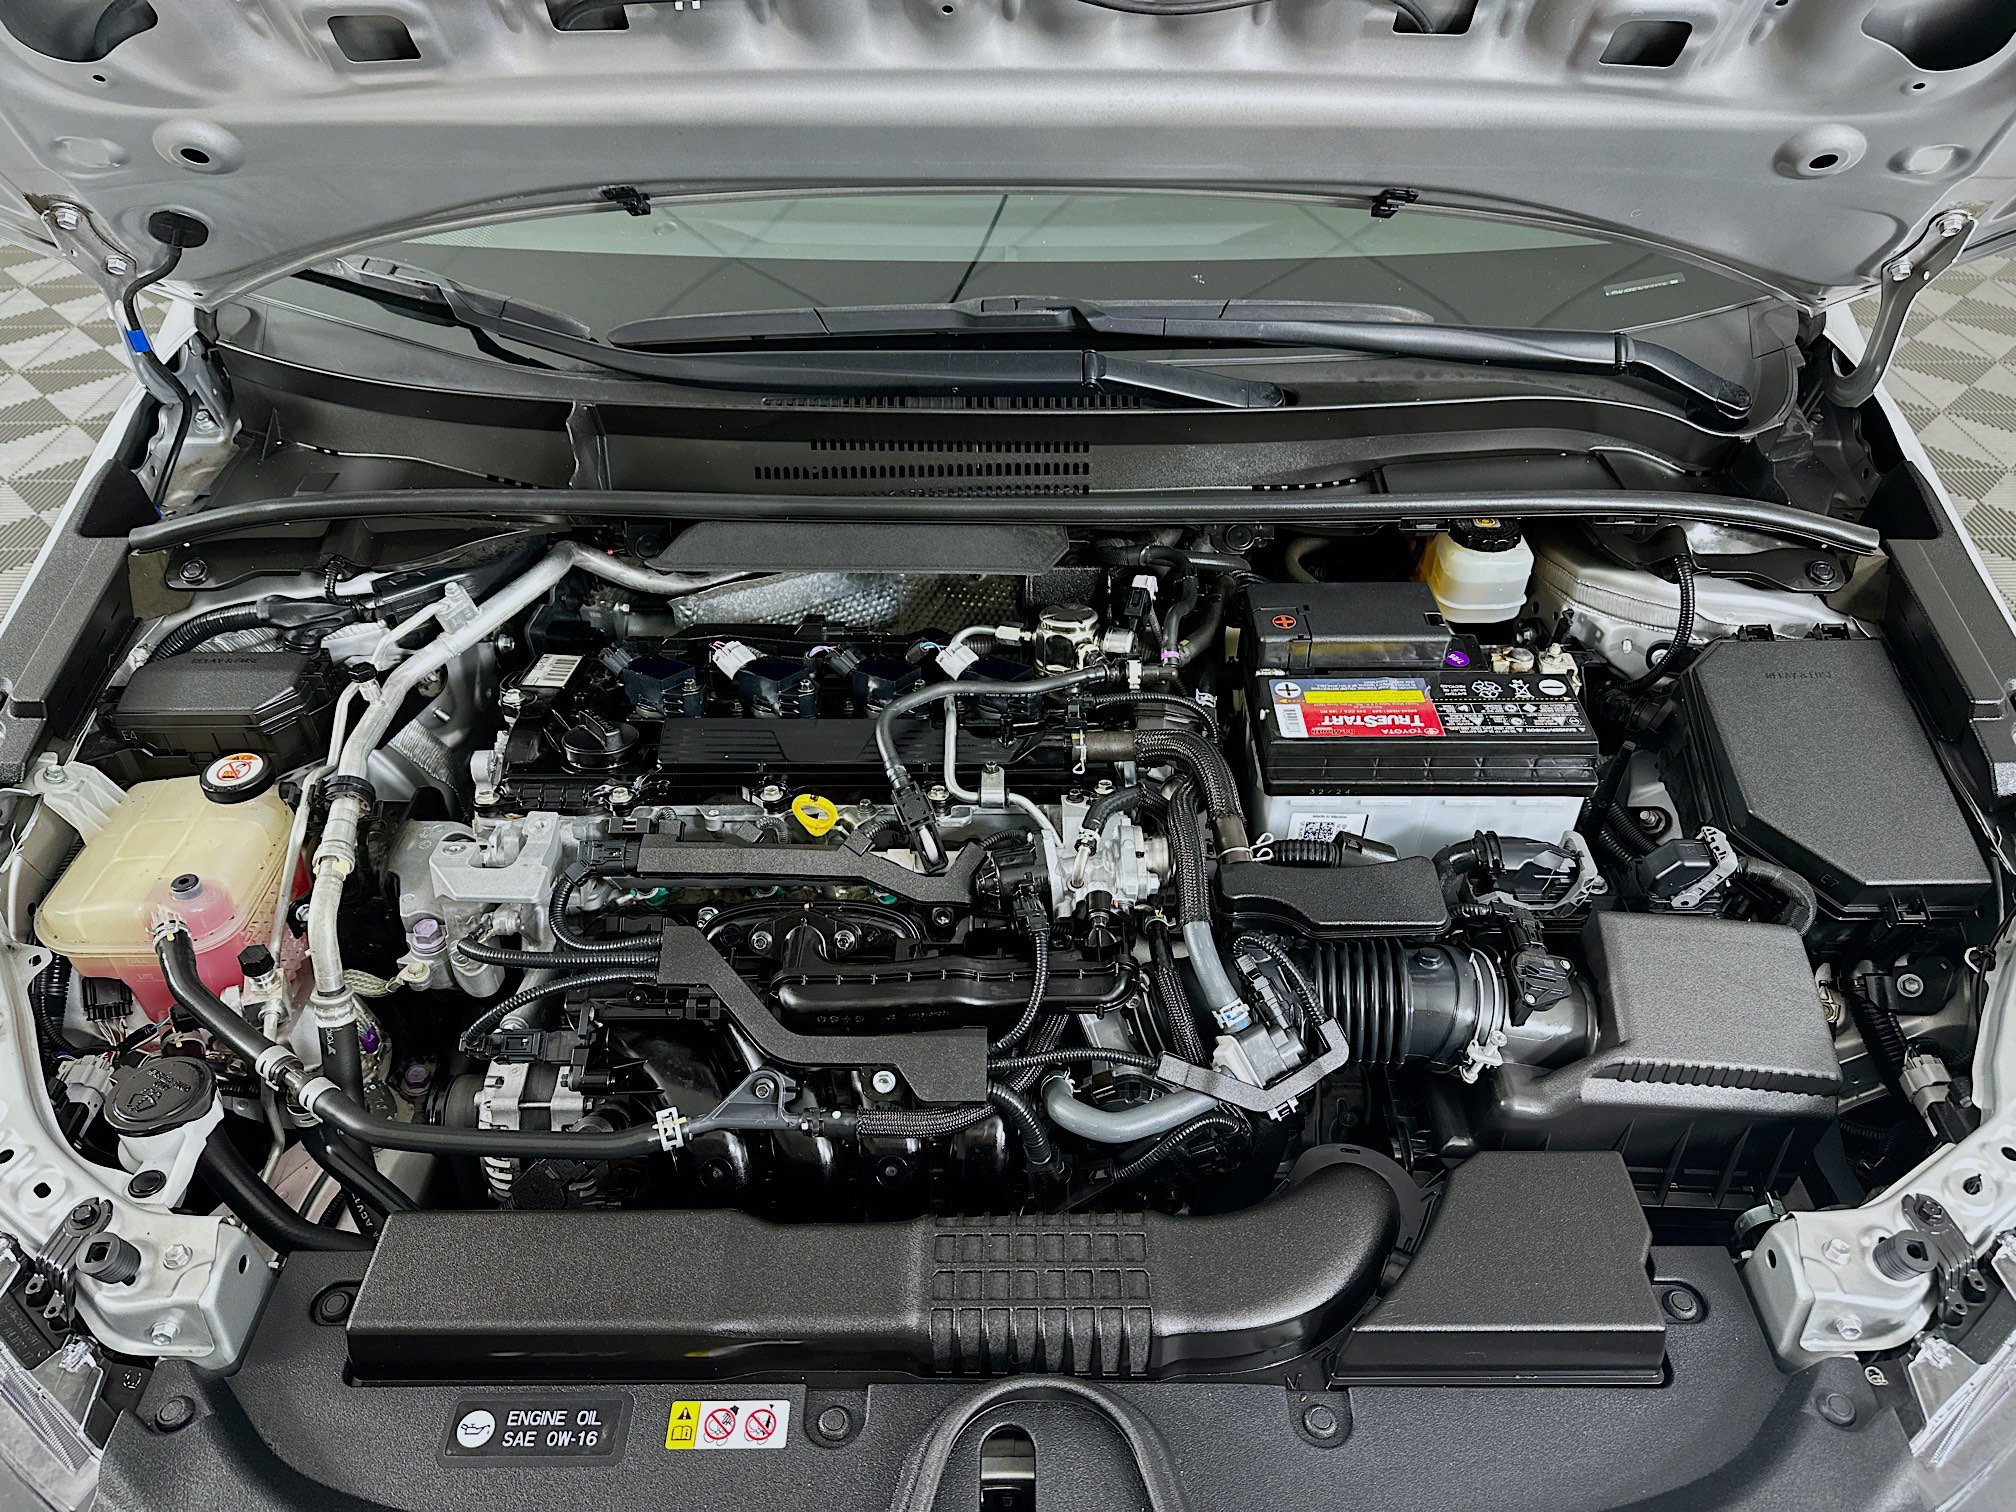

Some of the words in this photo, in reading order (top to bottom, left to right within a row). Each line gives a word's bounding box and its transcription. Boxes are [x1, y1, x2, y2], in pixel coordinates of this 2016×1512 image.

[506, 1410, 568, 1426] ENGINE
[576, 1410, 602, 1426] OIL
[502, 1431, 537, 1447] SAE
[546, 1431, 599, 1447] 0W-16
